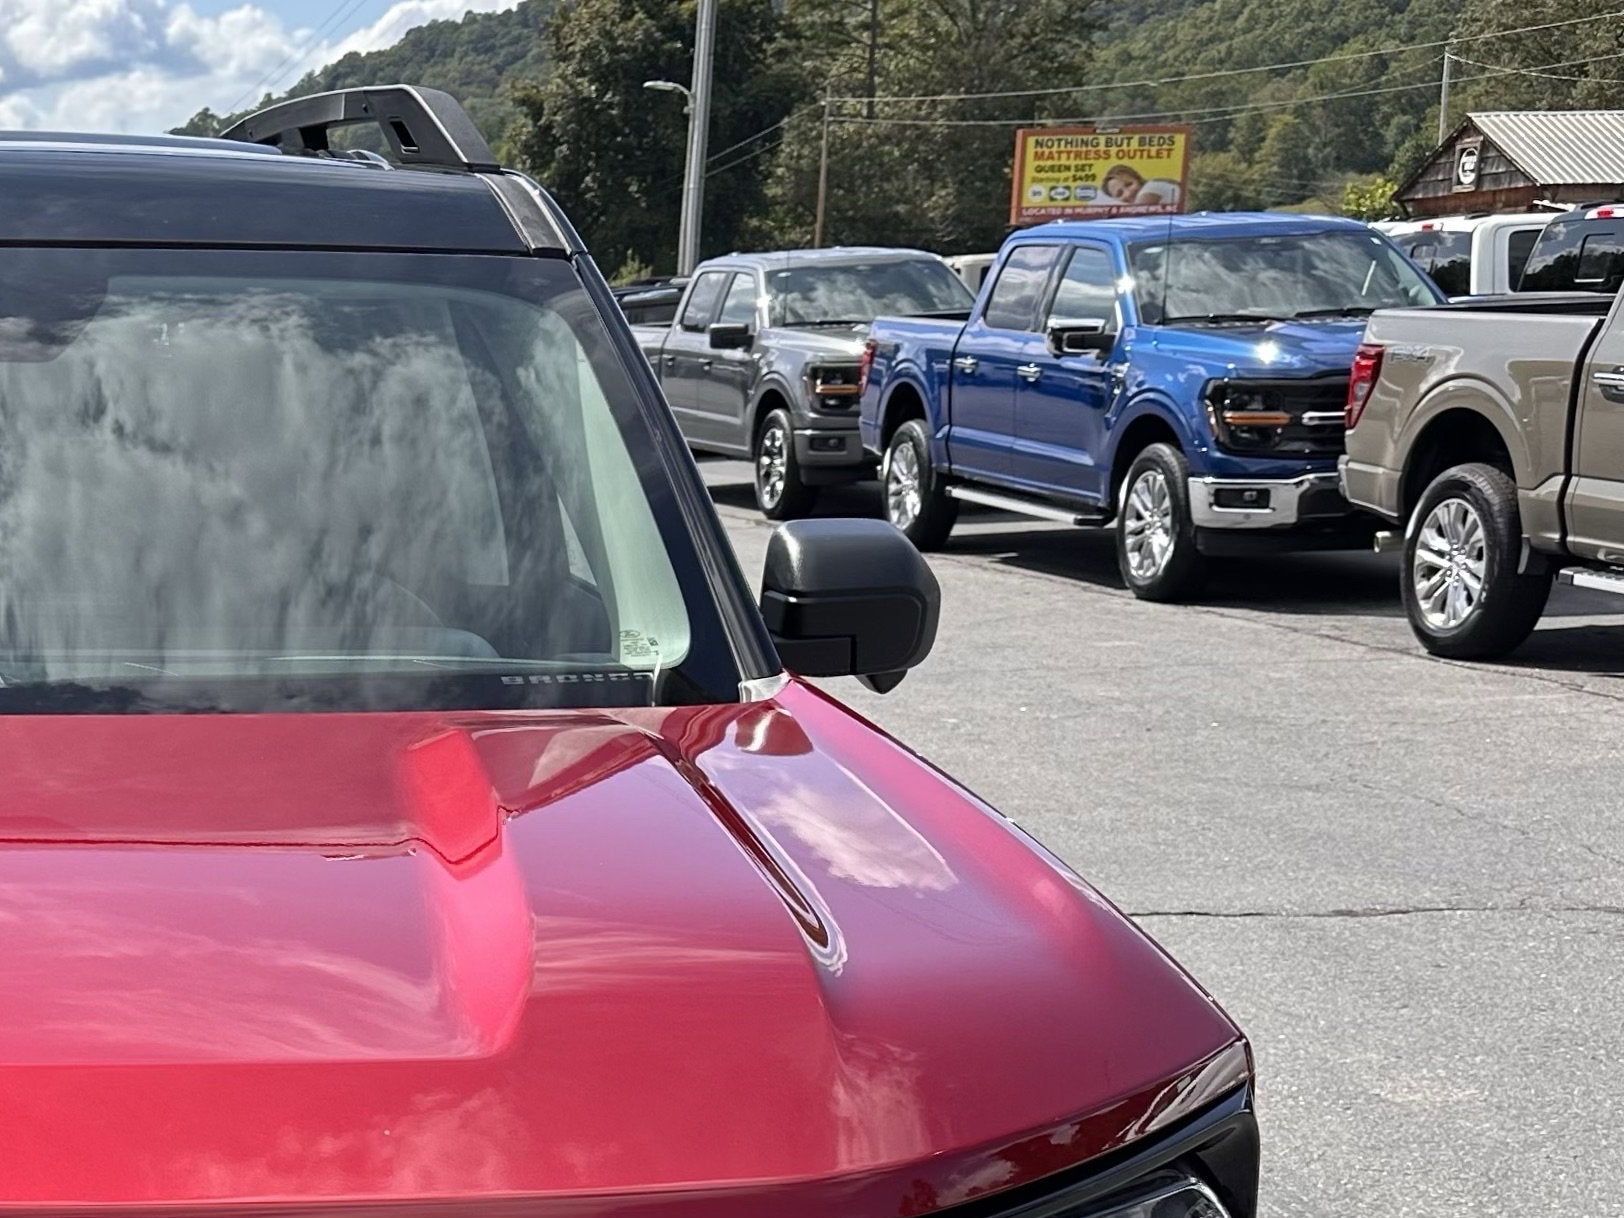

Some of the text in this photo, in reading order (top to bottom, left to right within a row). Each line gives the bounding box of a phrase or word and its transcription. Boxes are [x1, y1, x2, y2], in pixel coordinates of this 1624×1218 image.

[1034, 135, 1175, 149] NOTHING BUT BEDS
[1033, 148, 1174, 161] MATTRESS OUTLET
[1034, 163, 1094, 173] QUEEN SET
[1022, 207, 1062, 217] LOCATED
